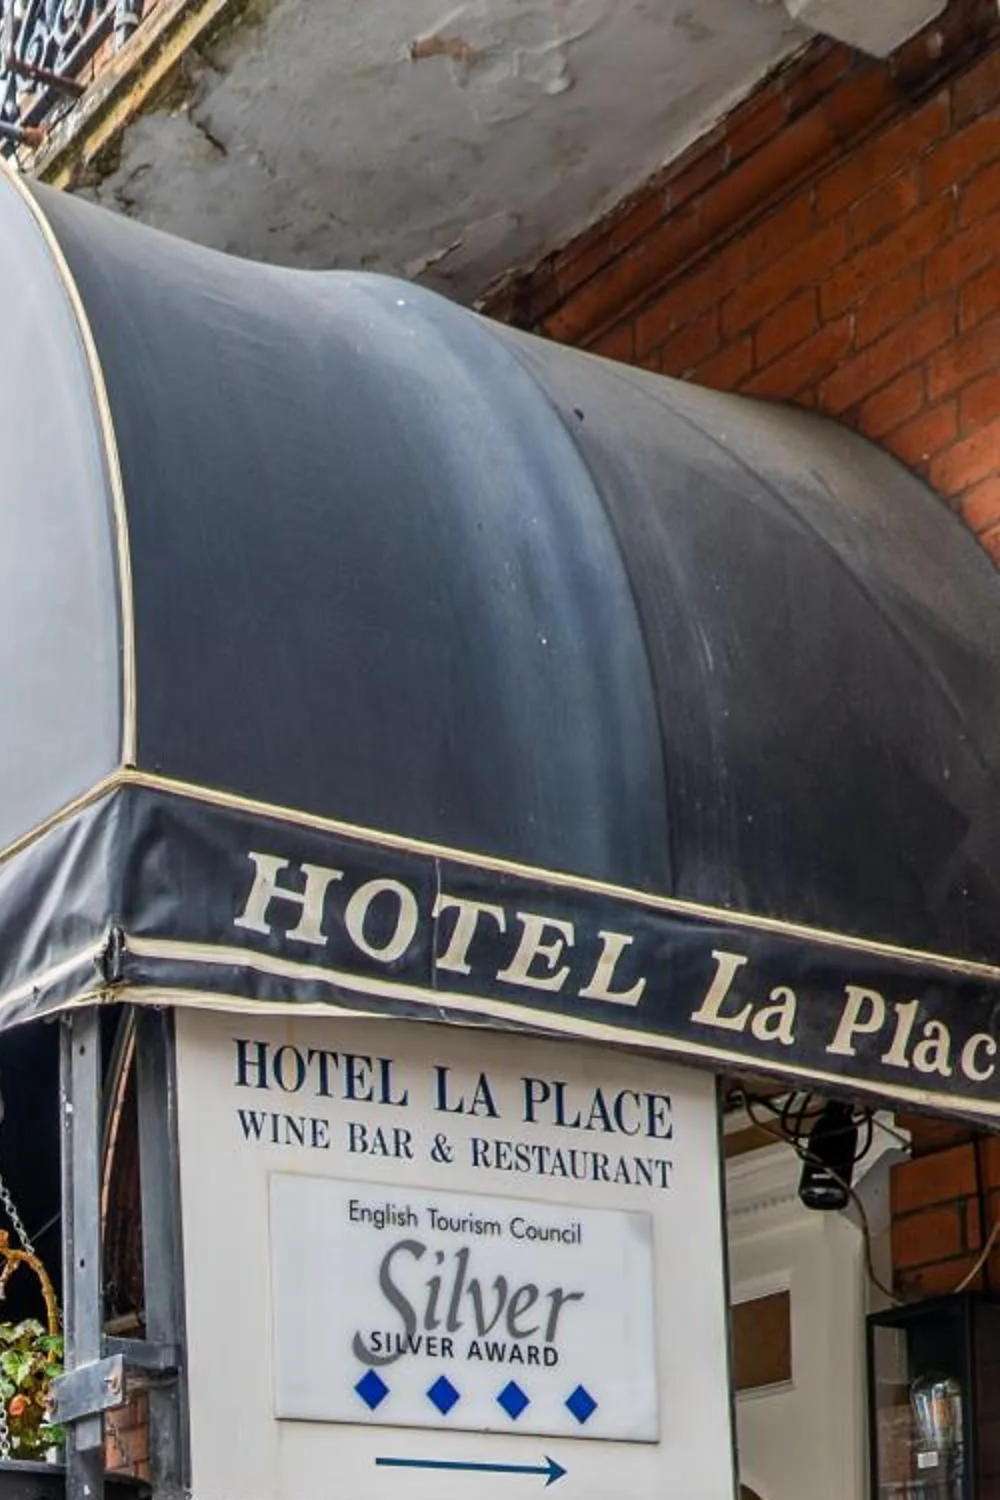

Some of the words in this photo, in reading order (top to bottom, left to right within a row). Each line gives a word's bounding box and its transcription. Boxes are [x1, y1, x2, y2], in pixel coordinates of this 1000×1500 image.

[233, 851, 647, 1007] HOTEL
[690, 949, 796, 1045] La
[232, 1038, 409, 1106] HOTEL
[433, 1065, 501, 1119] LA
[521, 1077, 673, 1140] PLACE
[237, 1109, 330, 1149] WINE
[347, 1122, 414, 1160] BAR
[430, 1132, 454, 1164] &
[471, 1137, 673, 1189] RESTAURANT
[348, 1199, 419, 1230] English
[427, 1207, 501, 1237] Tourism
[509, 1216, 582, 1245] Council
[352, 1239, 585, 1367] Silver
[370, 1331, 454, 1359] SILVER
[467, 1339, 560, 1368] AWARD
